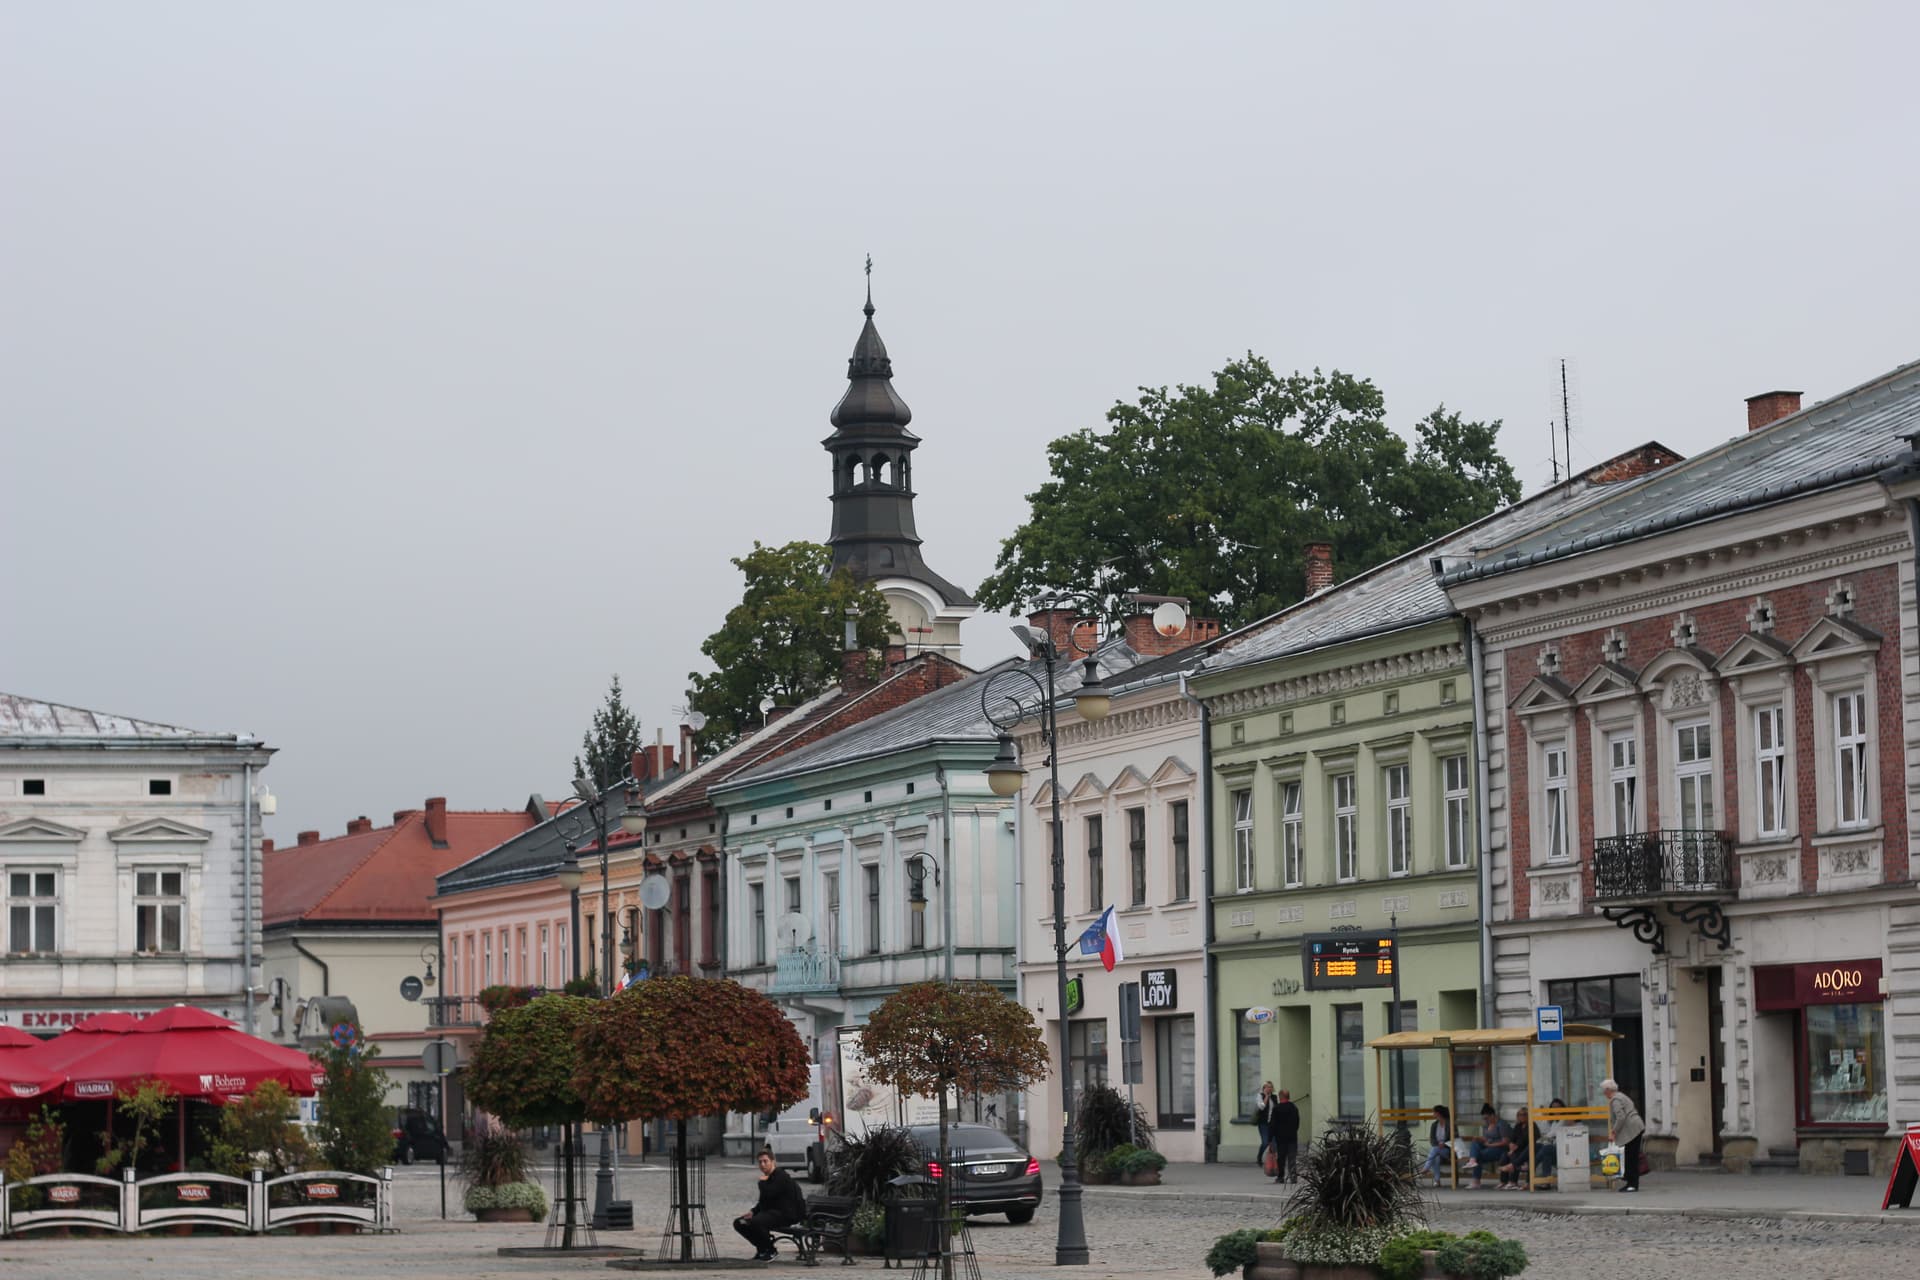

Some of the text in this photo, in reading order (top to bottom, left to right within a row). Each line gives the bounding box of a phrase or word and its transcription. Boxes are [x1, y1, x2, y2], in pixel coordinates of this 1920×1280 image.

[1342, 946, 1360, 956] Rynek
[1147, 971, 1165, 985] PRZE
[1814, 969, 1862, 990] ADORO
[78, 1083, 111, 1094] WARKA
[51, 1189, 79, 1198] WARKA
[179, 1188, 208, 1197] WARKA
[308, 1186, 338, 1195] WARKA
